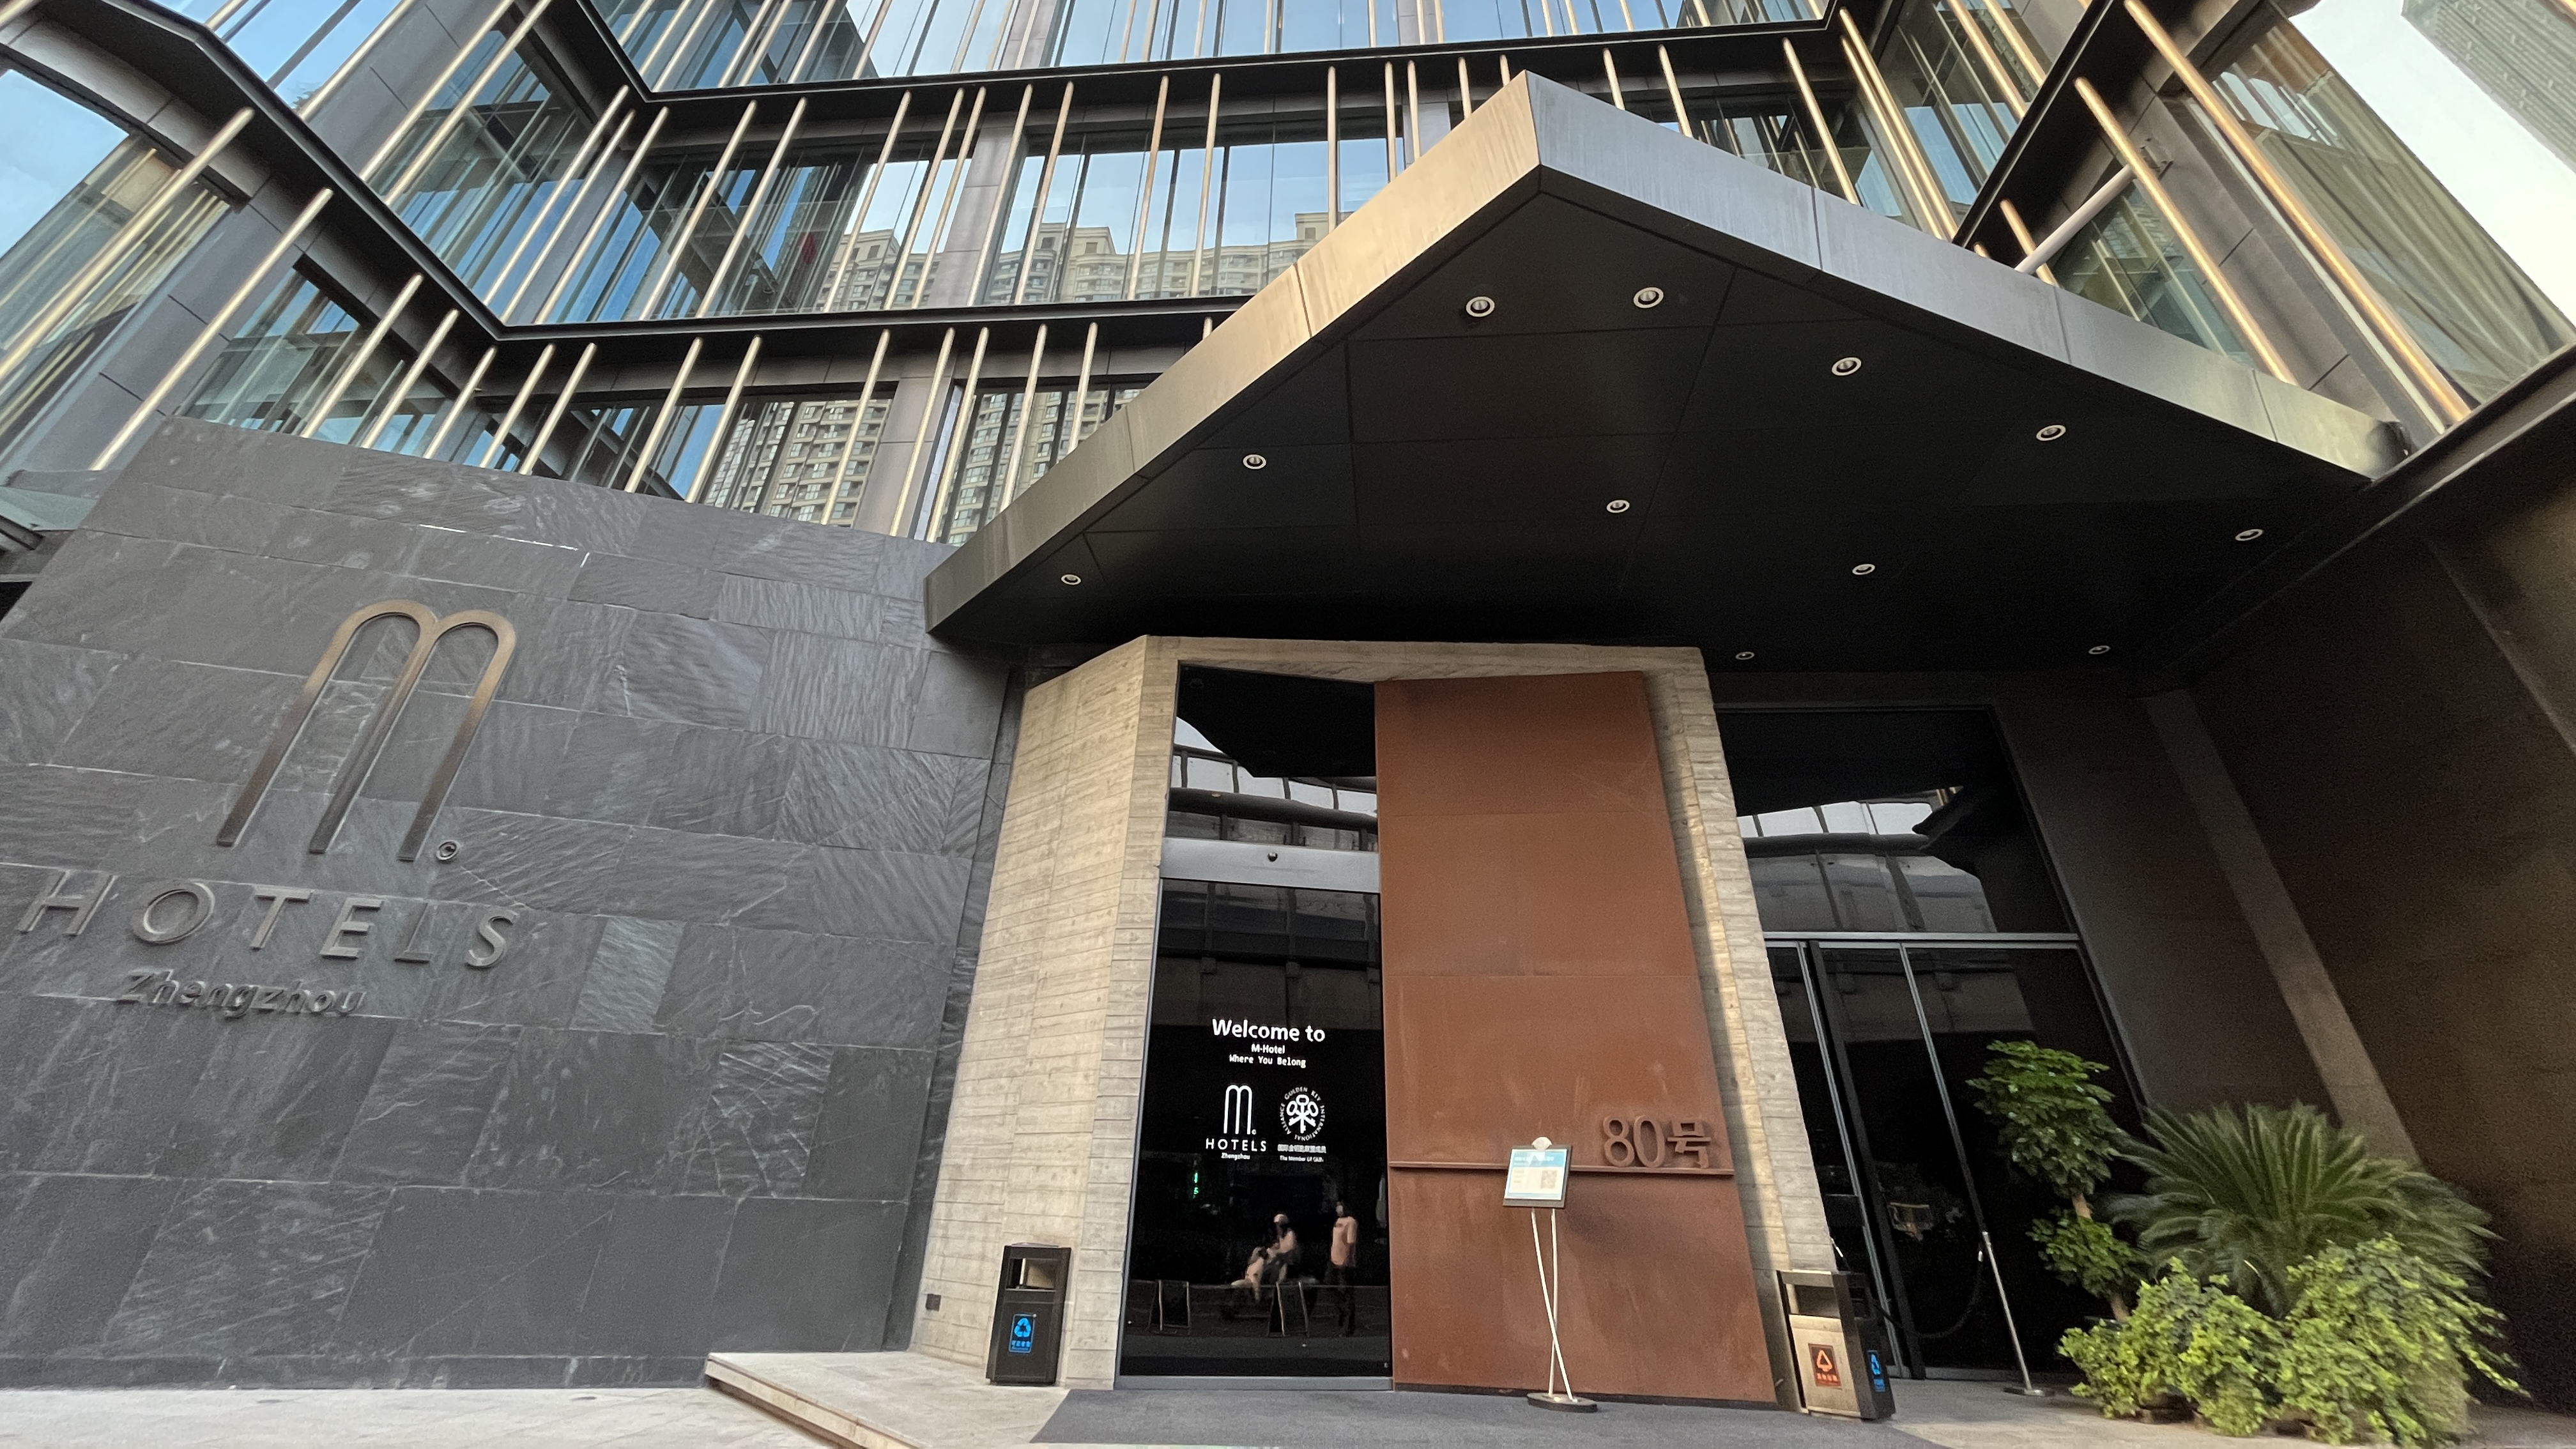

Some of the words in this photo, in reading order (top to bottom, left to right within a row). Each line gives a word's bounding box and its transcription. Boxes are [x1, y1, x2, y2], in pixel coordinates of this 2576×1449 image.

[17, 869, 520, 969] HOTELS
[114, 967, 367, 1019] Zhengzhou
[1212, 1018, 1300, 1041] Welcome
[1305, 1025, 1326, 1042] to
[1229, 1054, 1254, 1064] Where
[1258, 1055, 1273, 1064] You
[1276, 1057, 1307, 1068] Belong
[1284, 1086, 1308, 1100] GOLDEN
[1206, 1138, 1267, 1152] HOTELS
[1602, 1115, 1712, 1169] 80号
